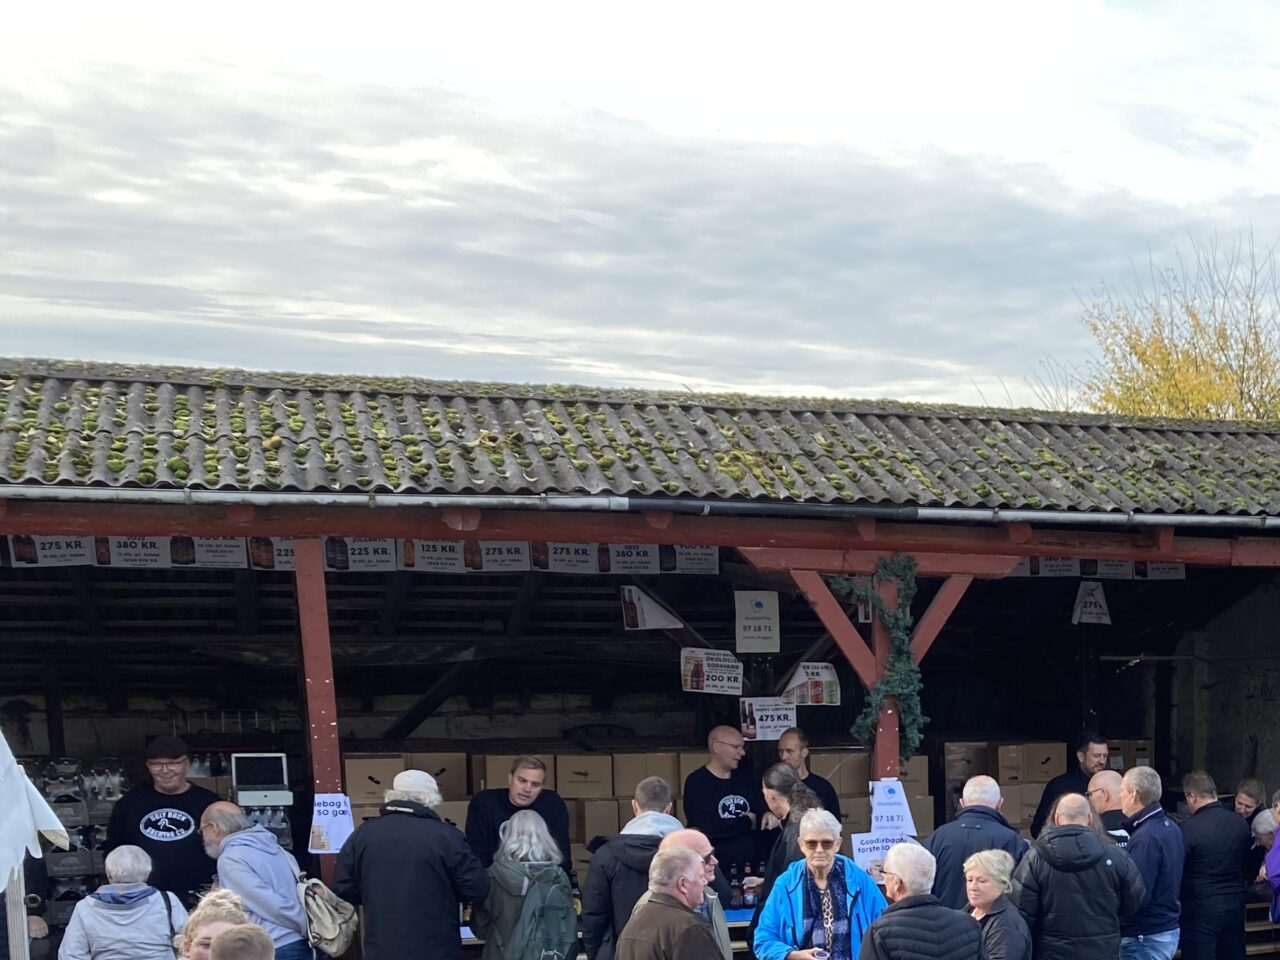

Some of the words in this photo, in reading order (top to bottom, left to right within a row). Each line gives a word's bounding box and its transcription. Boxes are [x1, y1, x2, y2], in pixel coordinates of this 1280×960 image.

[40, 541, 62, 550] 275
[66, 540, 86, 549] KR.
[116, 541, 138, 549] 380
[141, 541, 160, 550] KR.
[422, 544, 438, 552] 125
[440, 544, 458, 553] KR.
[350, 548, 369, 556] 225
[373, 548, 391, 556] KR.
[553, 547, 571, 555] 275
[574, 548, 590, 556] KR.
[616, 550, 633, 558] 380
[636, 550, 650, 558] KR.
[706, 674, 725, 682] 200
[758, 714, 775, 722] 475
[776, 714, 791, 722] KR.
[874, 814, 884, 822] 97
